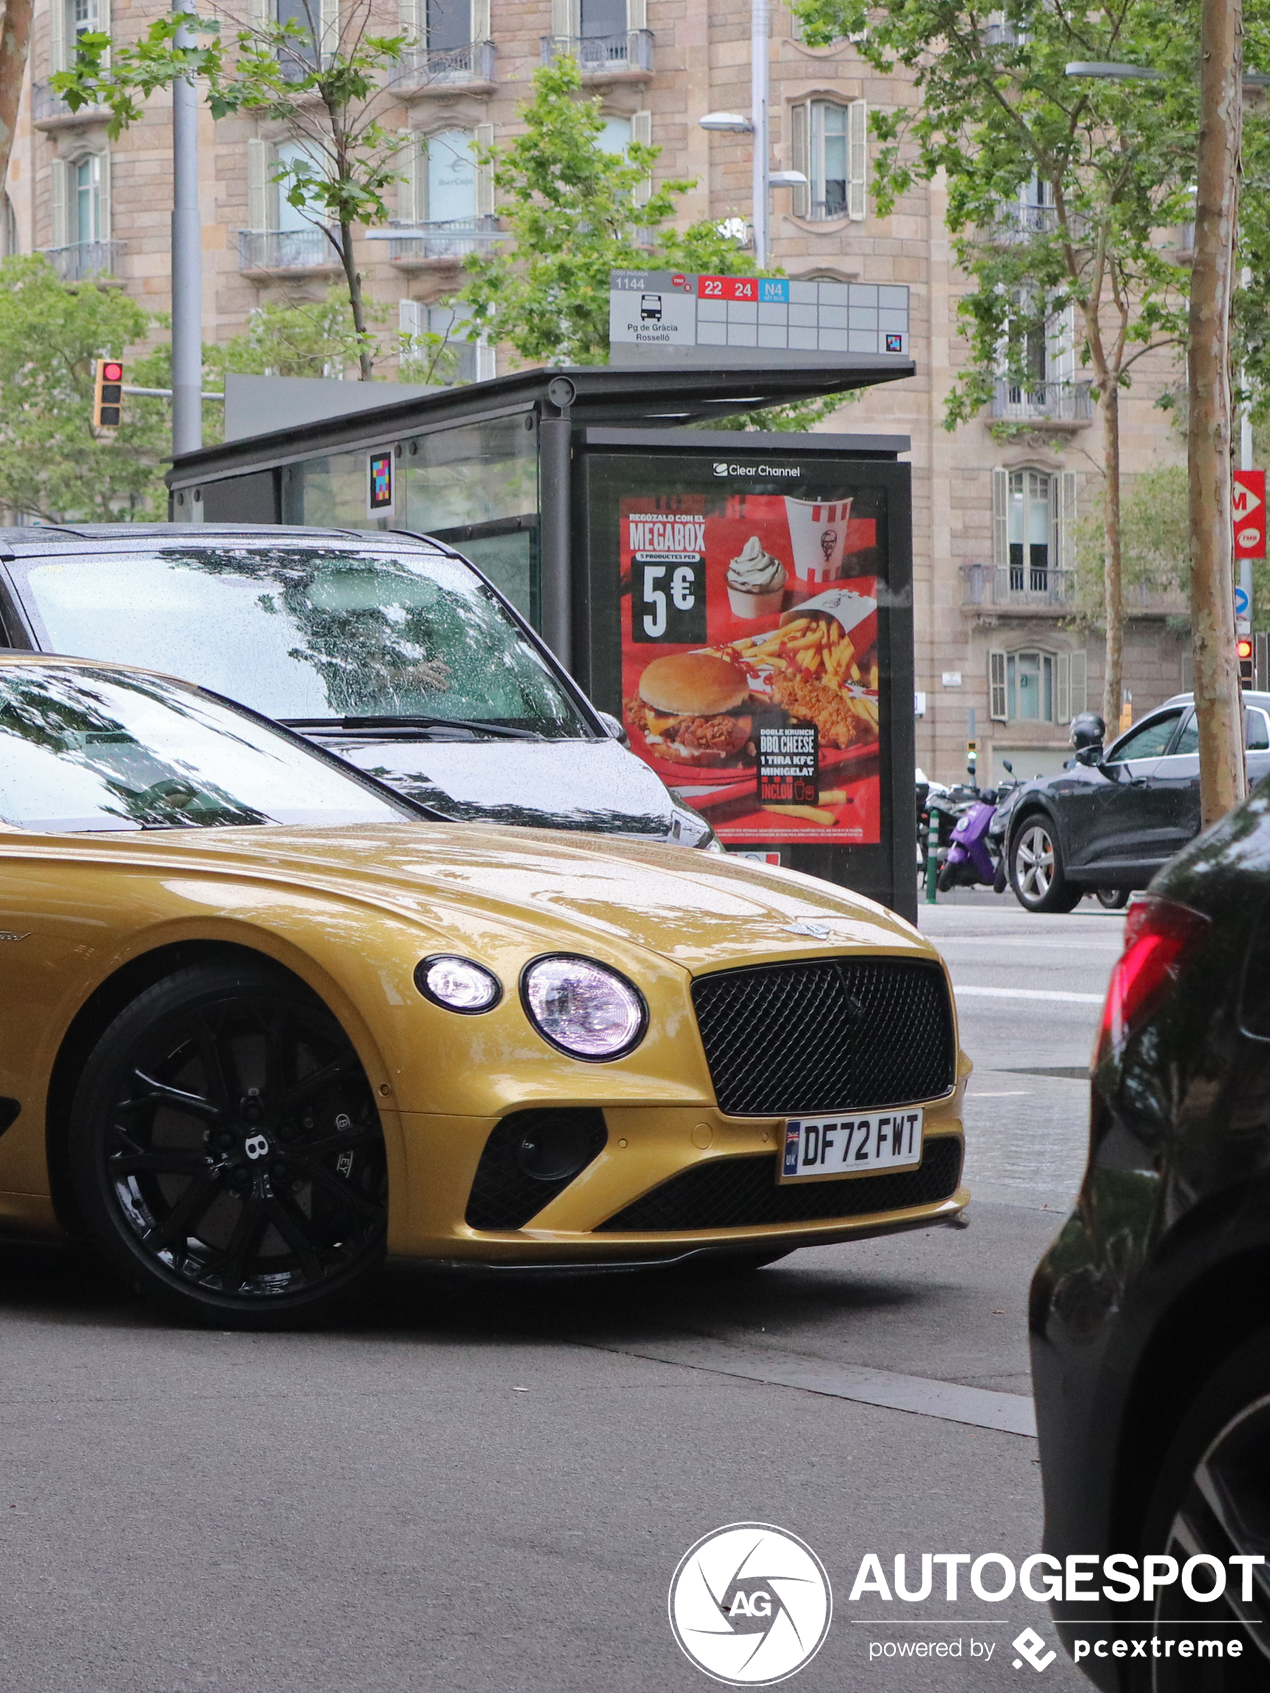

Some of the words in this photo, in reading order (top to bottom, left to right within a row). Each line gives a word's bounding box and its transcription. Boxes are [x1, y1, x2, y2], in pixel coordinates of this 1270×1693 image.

[616, 277, 645, 289] 1144
[704, 281, 722, 295] 22
[734, 283, 752, 297] 24
[765, 283, 783, 295] N4
[627, 324, 638, 332] Pg
[636, 333, 670, 341] Rosselló
[729, 464, 757, 476] Clear
[758, 465, 800, 477] Channel
[1233, 493, 1247, 510] M
[629, 513, 674, 522] REGÓZALO
[675, 514, 693, 522] CON
[694, 515, 705, 523] EL
[629, 522, 706, 552] MEGABOX
[643, 565, 695, 638] 5€
[760, 736, 779, 753] BBQ
[780, 736, 814, 753] CHEESE
[760, 756, 765, 765] 1
[767, 756, 791, 765] TIRA
[793, 756, 814, 765] KFC
[761, 767, 814, 776] MINIGELAT
[761, 783, 793, 799] INCLOU
[244, 1134, 269, 1160] B
[802, 1120, 870, 1167] DF72
[876, 1114, 918, 1158] FWT
[785, 1154, 797, 1166] UK
